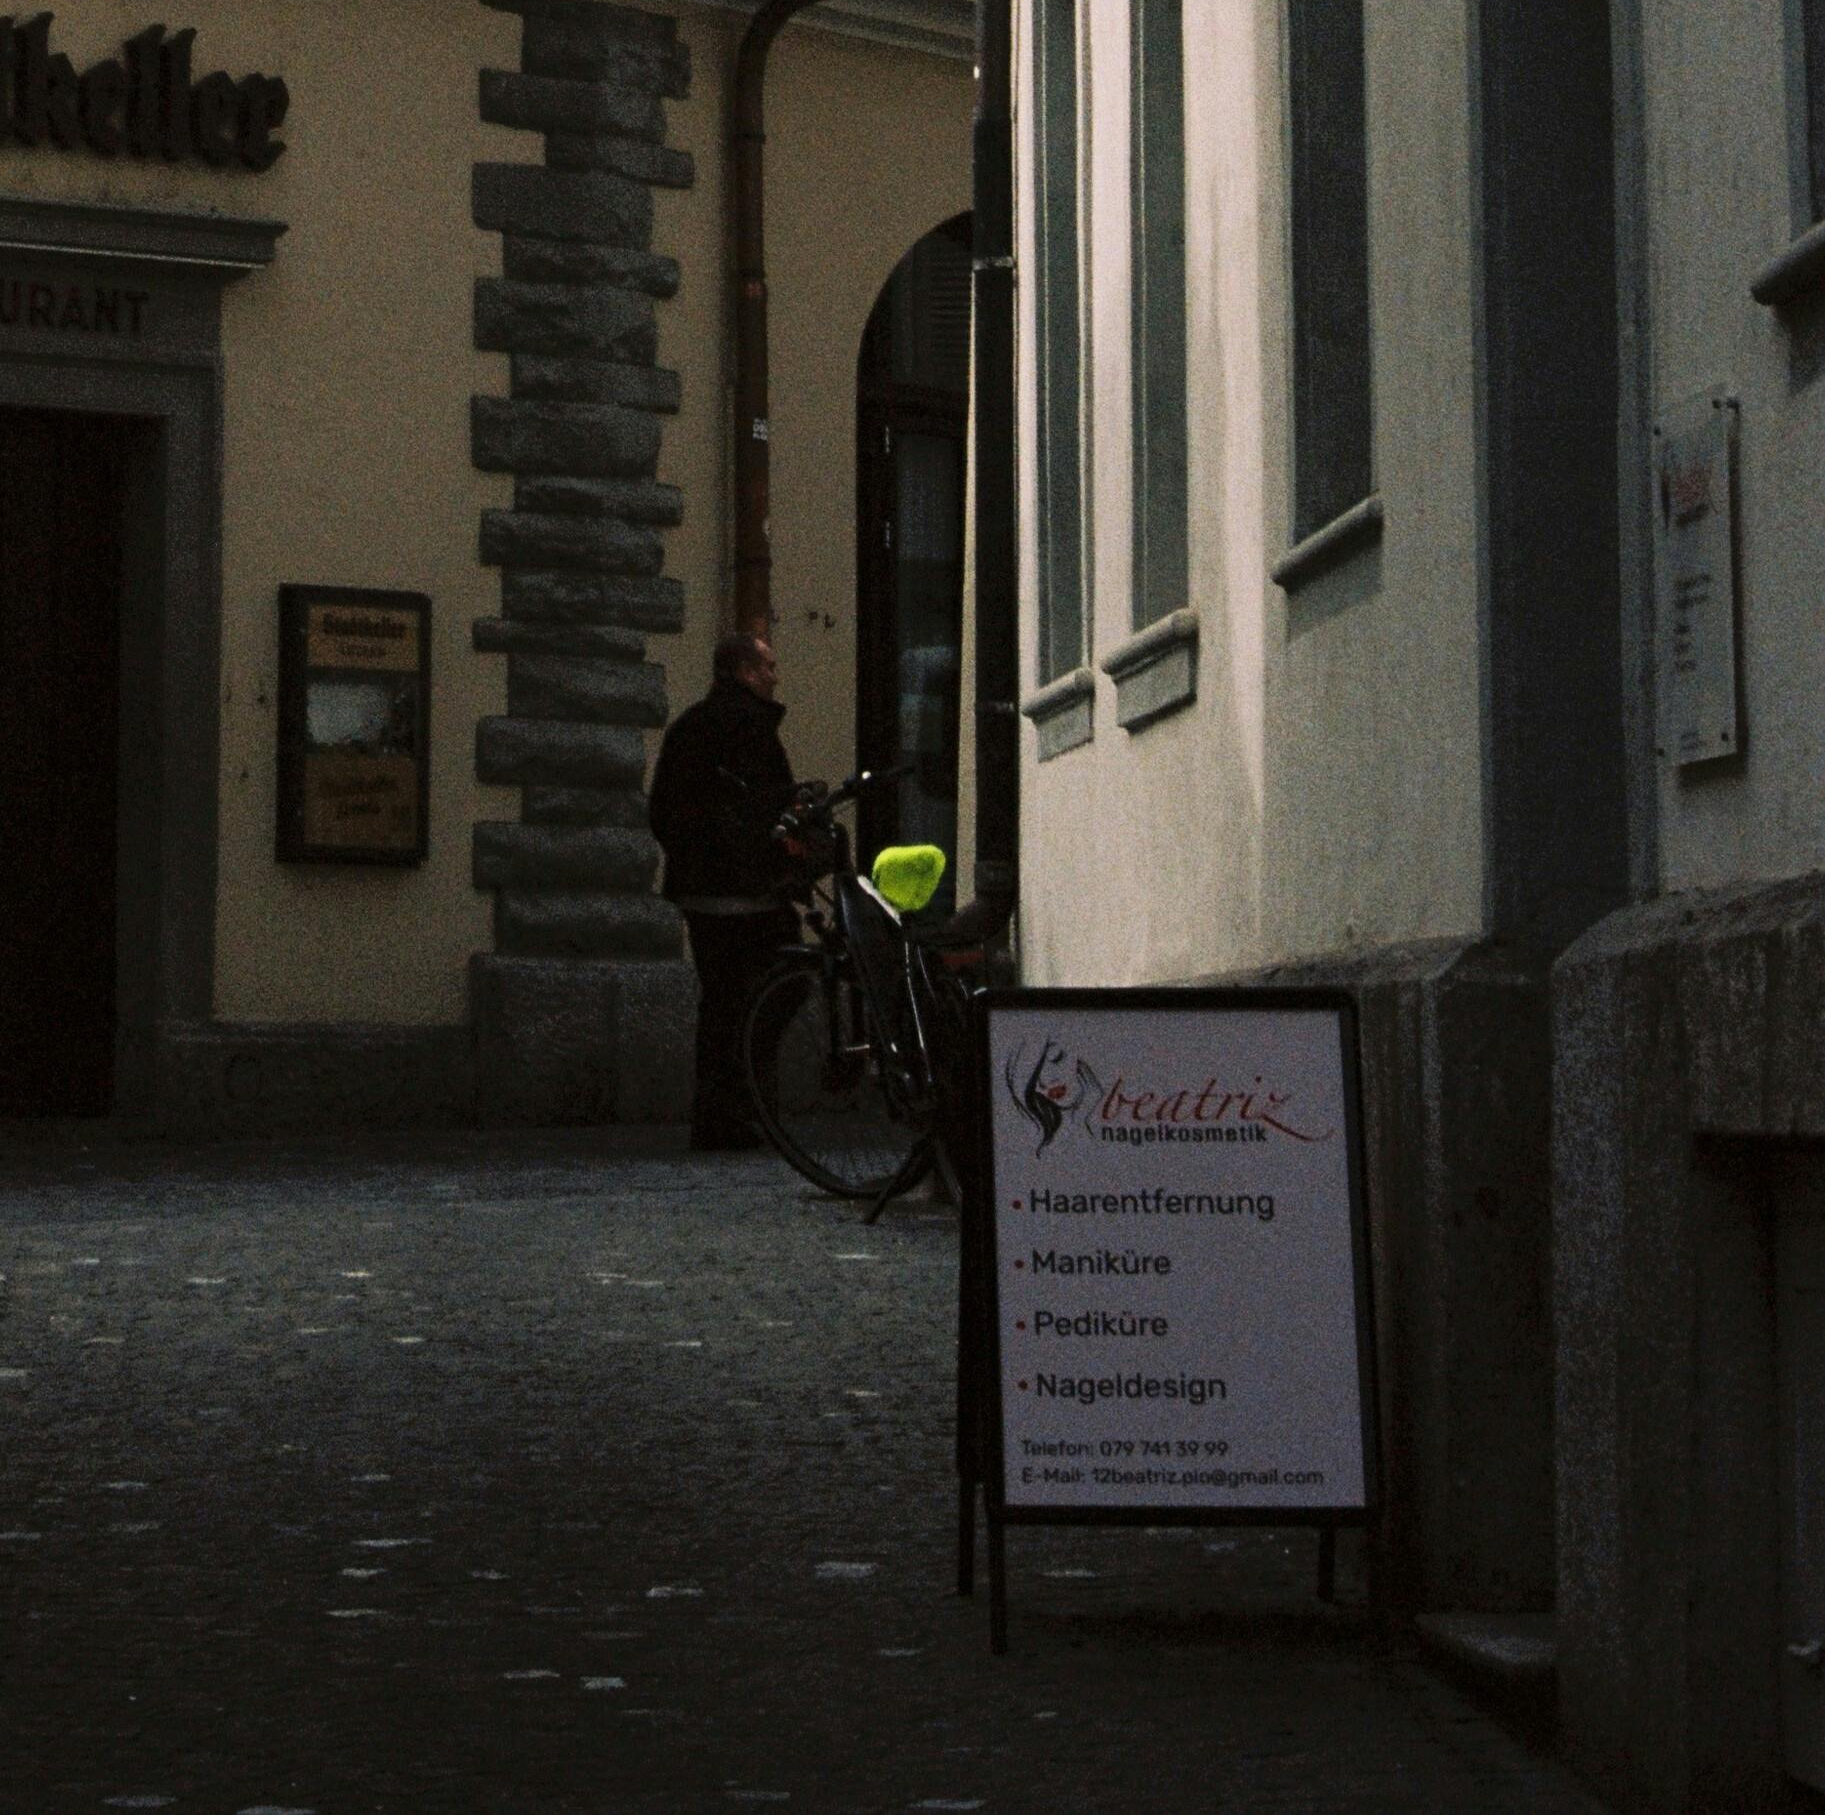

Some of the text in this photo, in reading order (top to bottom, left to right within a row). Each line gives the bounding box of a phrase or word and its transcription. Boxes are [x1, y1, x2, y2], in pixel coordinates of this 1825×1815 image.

[1101, 1076, 1334, 1142] beatriz
[1101, 1123, 1268, 1146] nagelkosmetik
[1029, 1187, 1275, 1222] Haarentfernung
[1032, 1249, 1172, 1275] Maniküre
[1033, 1310, 1169, 1337] Pediküre
[1035, 1372, 1228, 1406] Nageldesign
[1022, 1440, 1094, 1456] Telefon:
[1099, 1440, 1135, 1457] 079
[1139, 1441, 1172, 1457] 741
[1204, 1441, 1229, 1457] 99
[1022, 1466, 1086, 1484] E-Mail:
